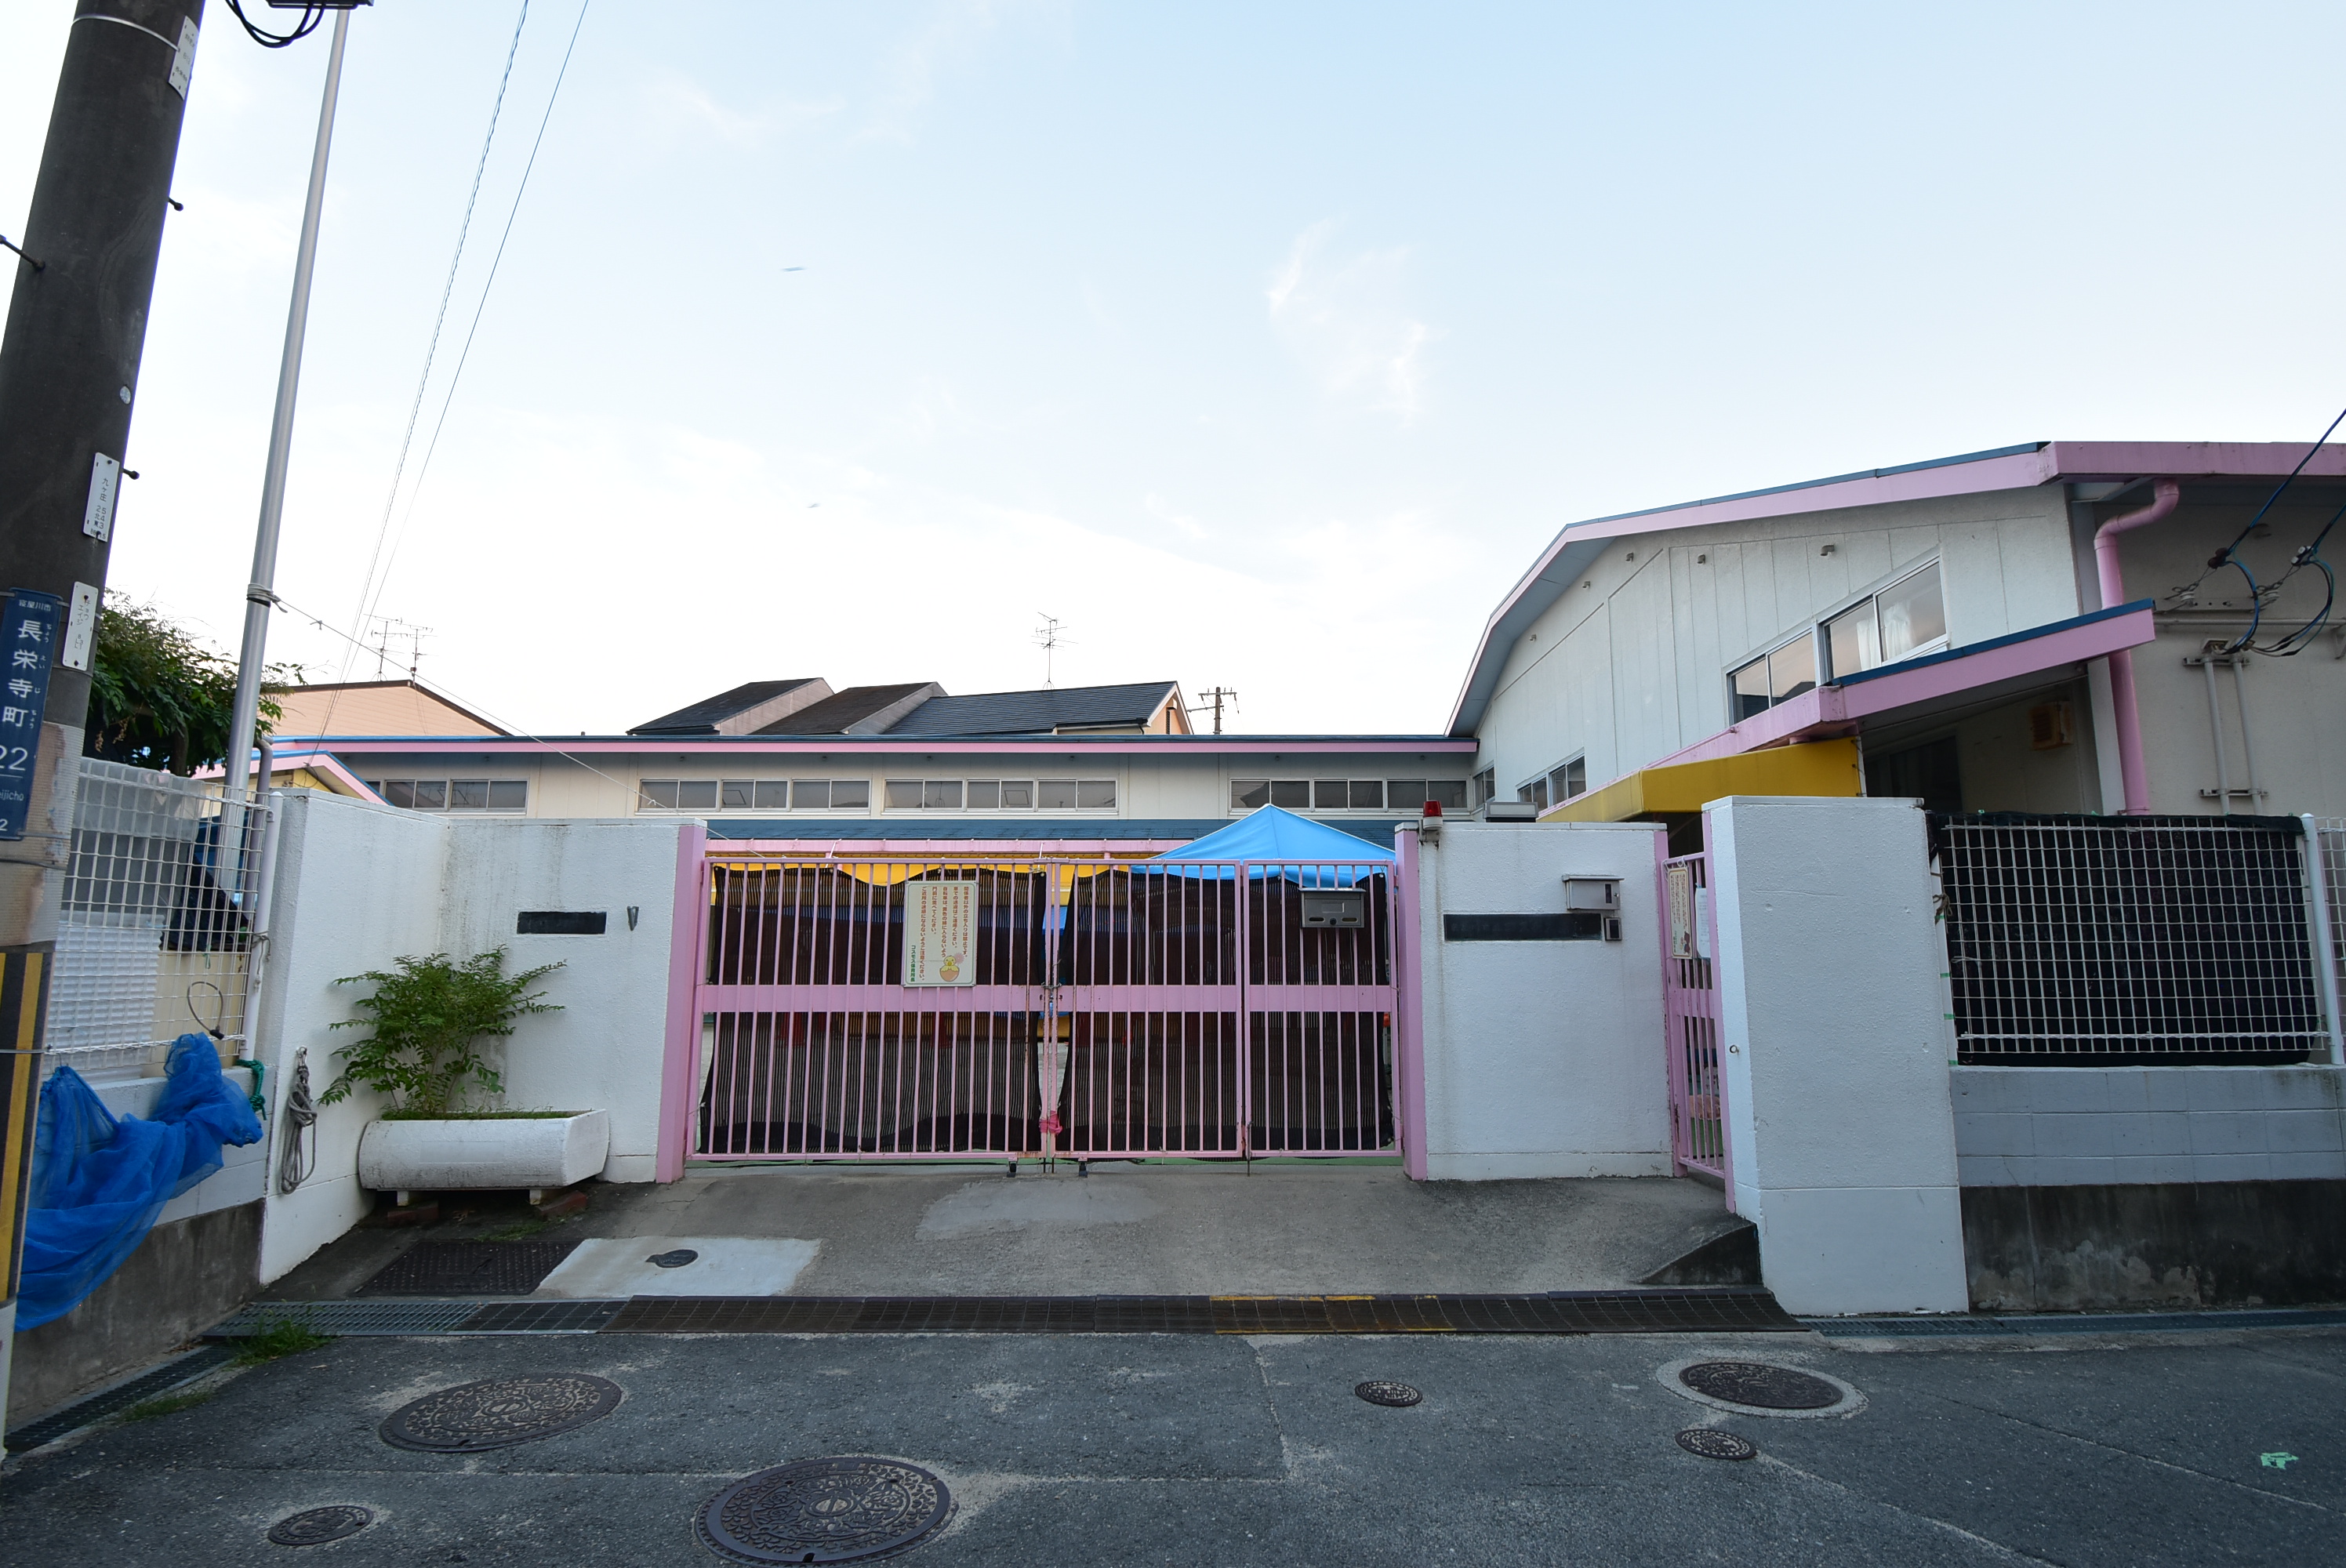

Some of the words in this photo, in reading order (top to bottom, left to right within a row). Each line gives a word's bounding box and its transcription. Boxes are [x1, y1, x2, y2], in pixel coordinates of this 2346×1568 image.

[96, 505, 107, 514] 25
[2, 619, 43, 728] 長栄寺町
